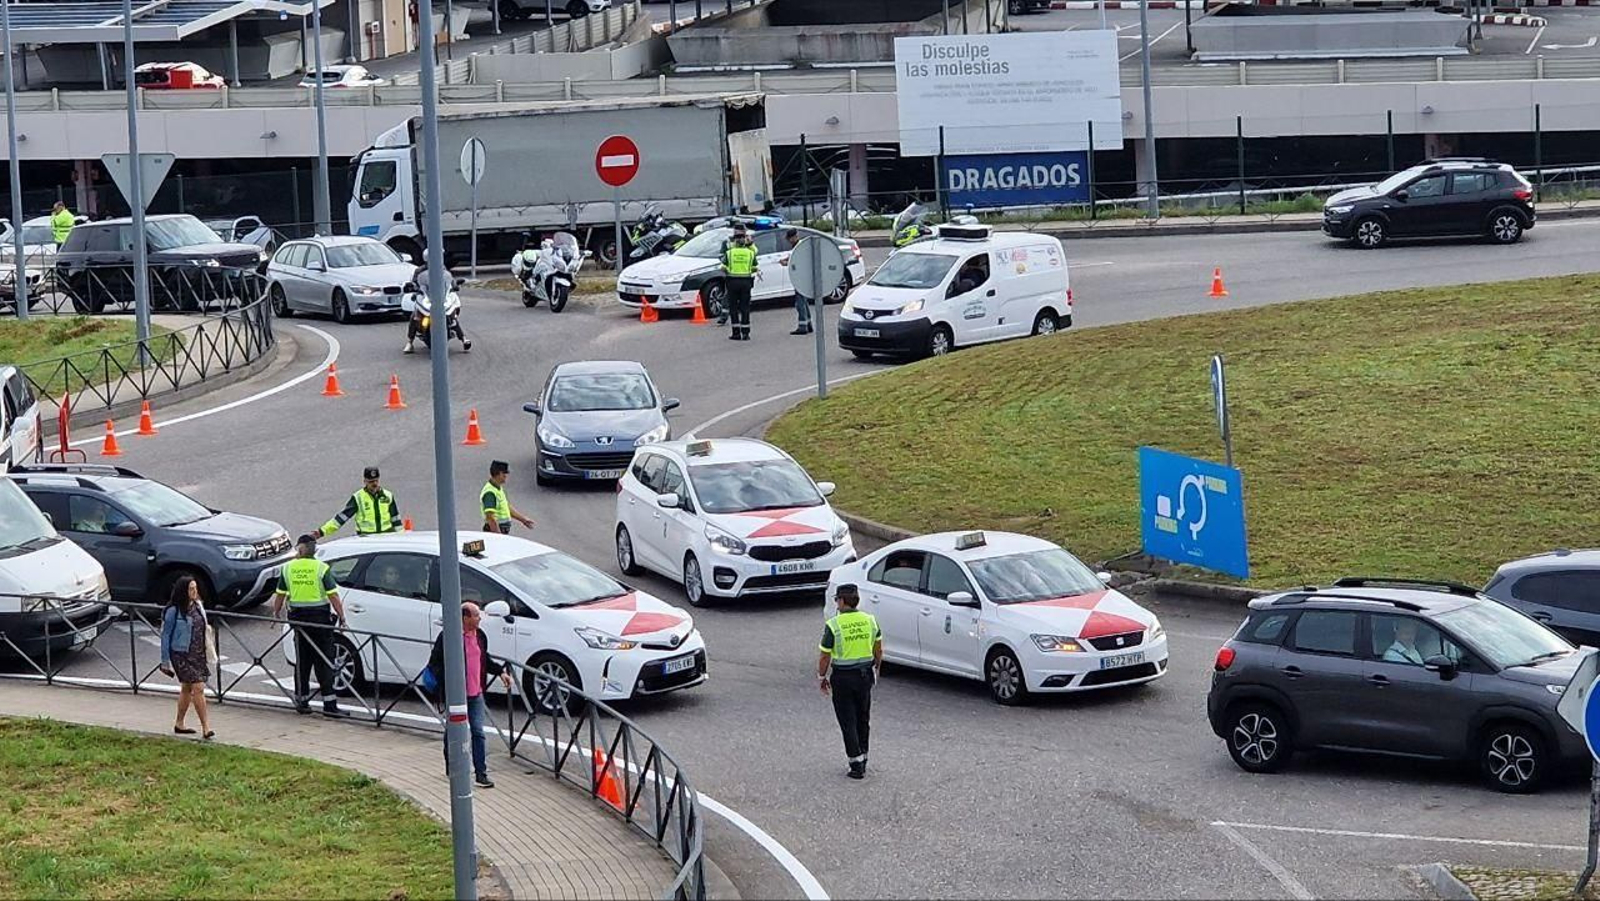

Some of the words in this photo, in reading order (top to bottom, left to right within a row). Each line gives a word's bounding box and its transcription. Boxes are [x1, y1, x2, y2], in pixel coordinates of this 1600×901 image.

[922, 42, 990, 61] Disculpe
[905, 62, 929, 77] las
[934, 58, 1010, 76] molestias
[948, 163, 1081, 191] DRAGADOS
[1105, 656, 1126, 667] 8572
